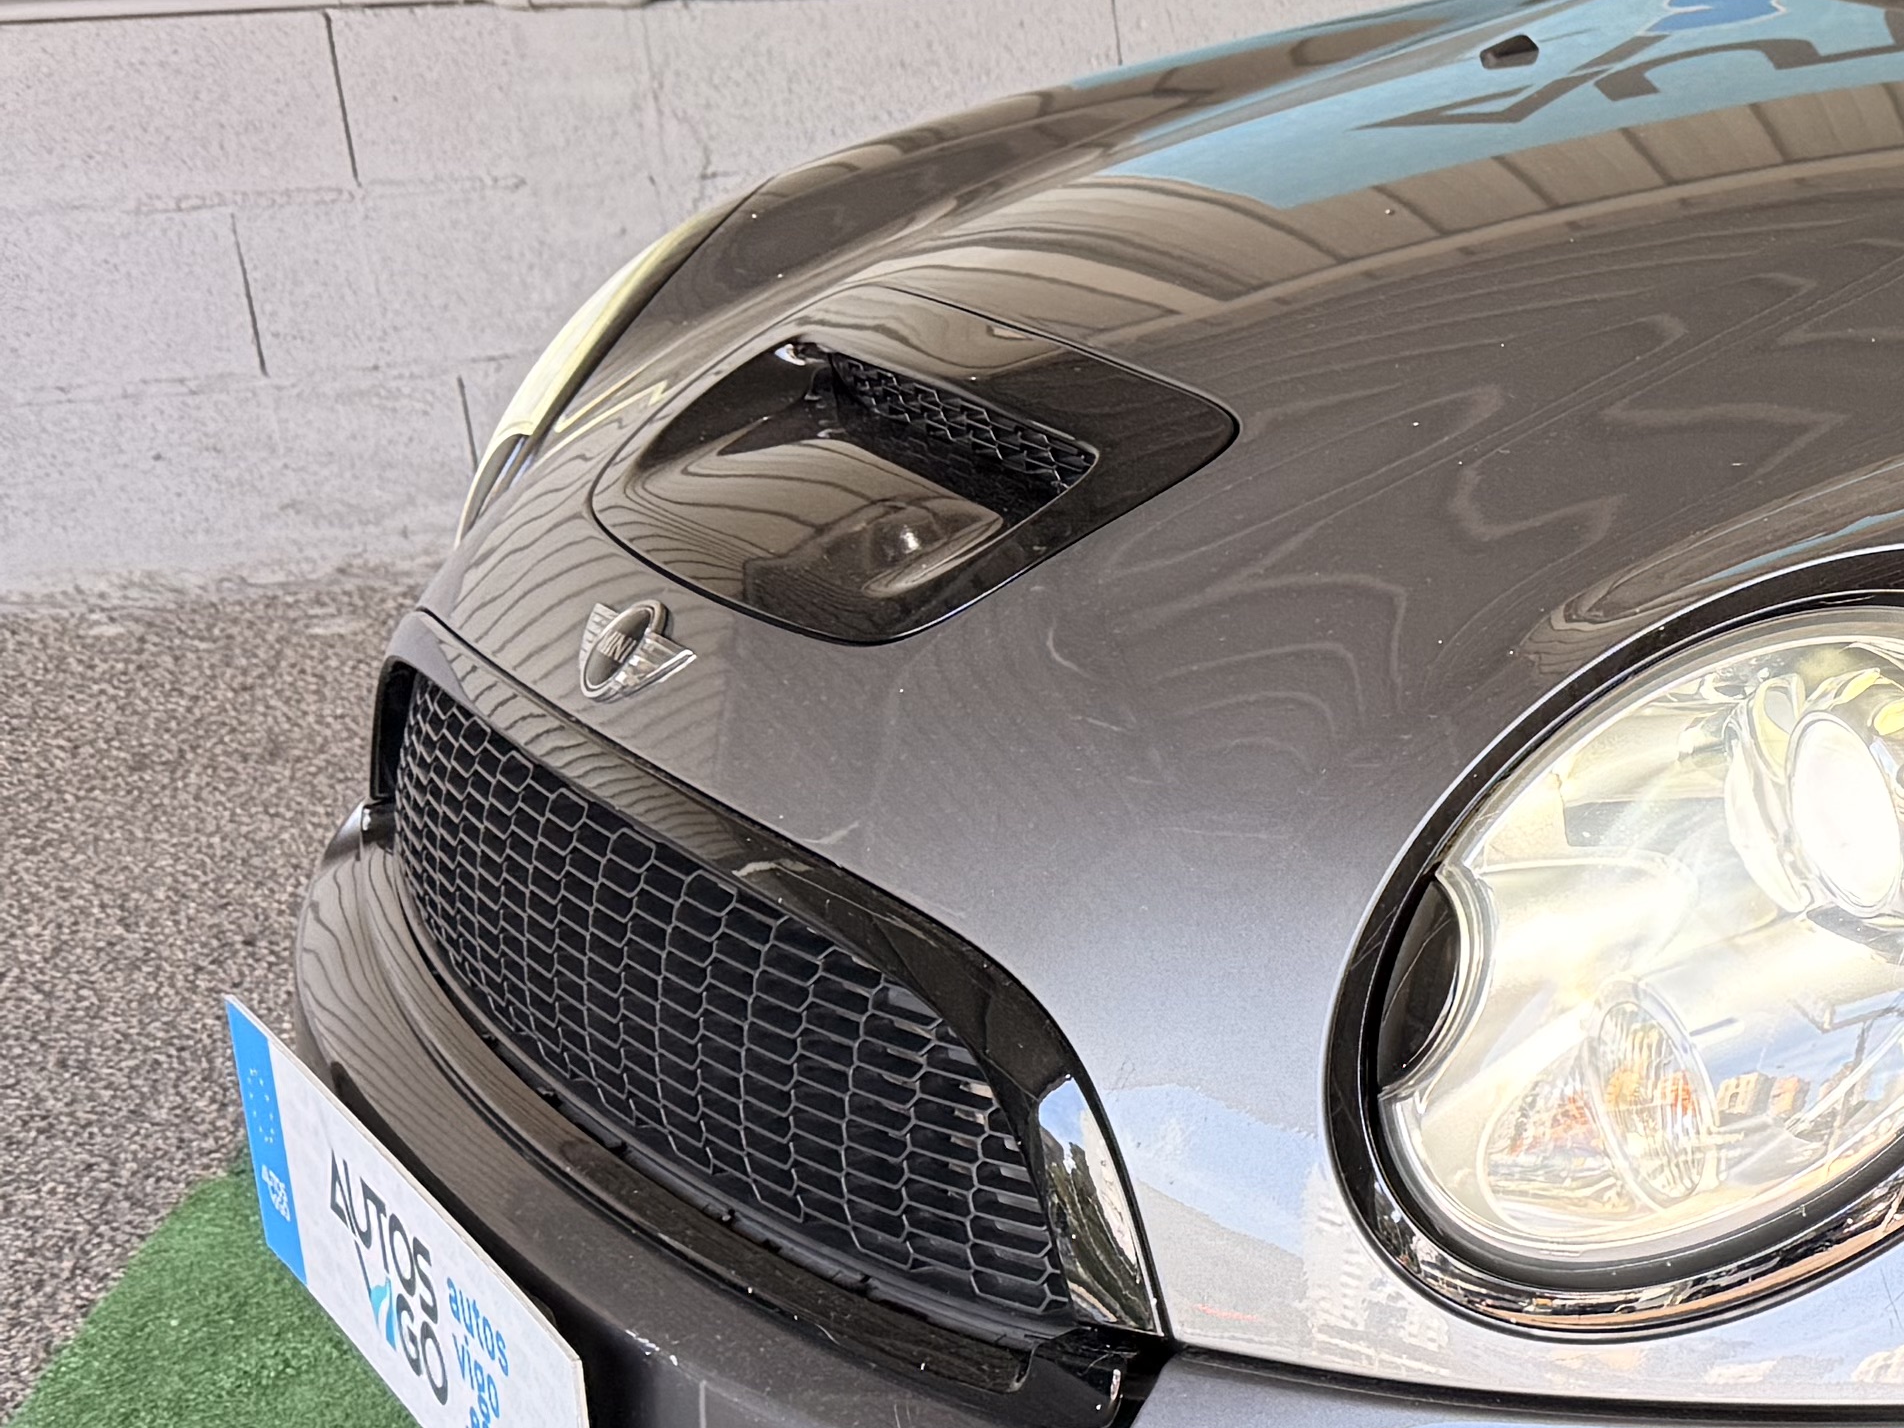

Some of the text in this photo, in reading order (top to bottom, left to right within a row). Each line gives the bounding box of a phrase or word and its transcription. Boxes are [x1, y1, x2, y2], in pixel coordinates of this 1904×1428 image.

[329, 1146, 440, 1326] AUTOS
[446, 1274, 510, 1378] autos
[450, 1330, 500, 1426] vigo
